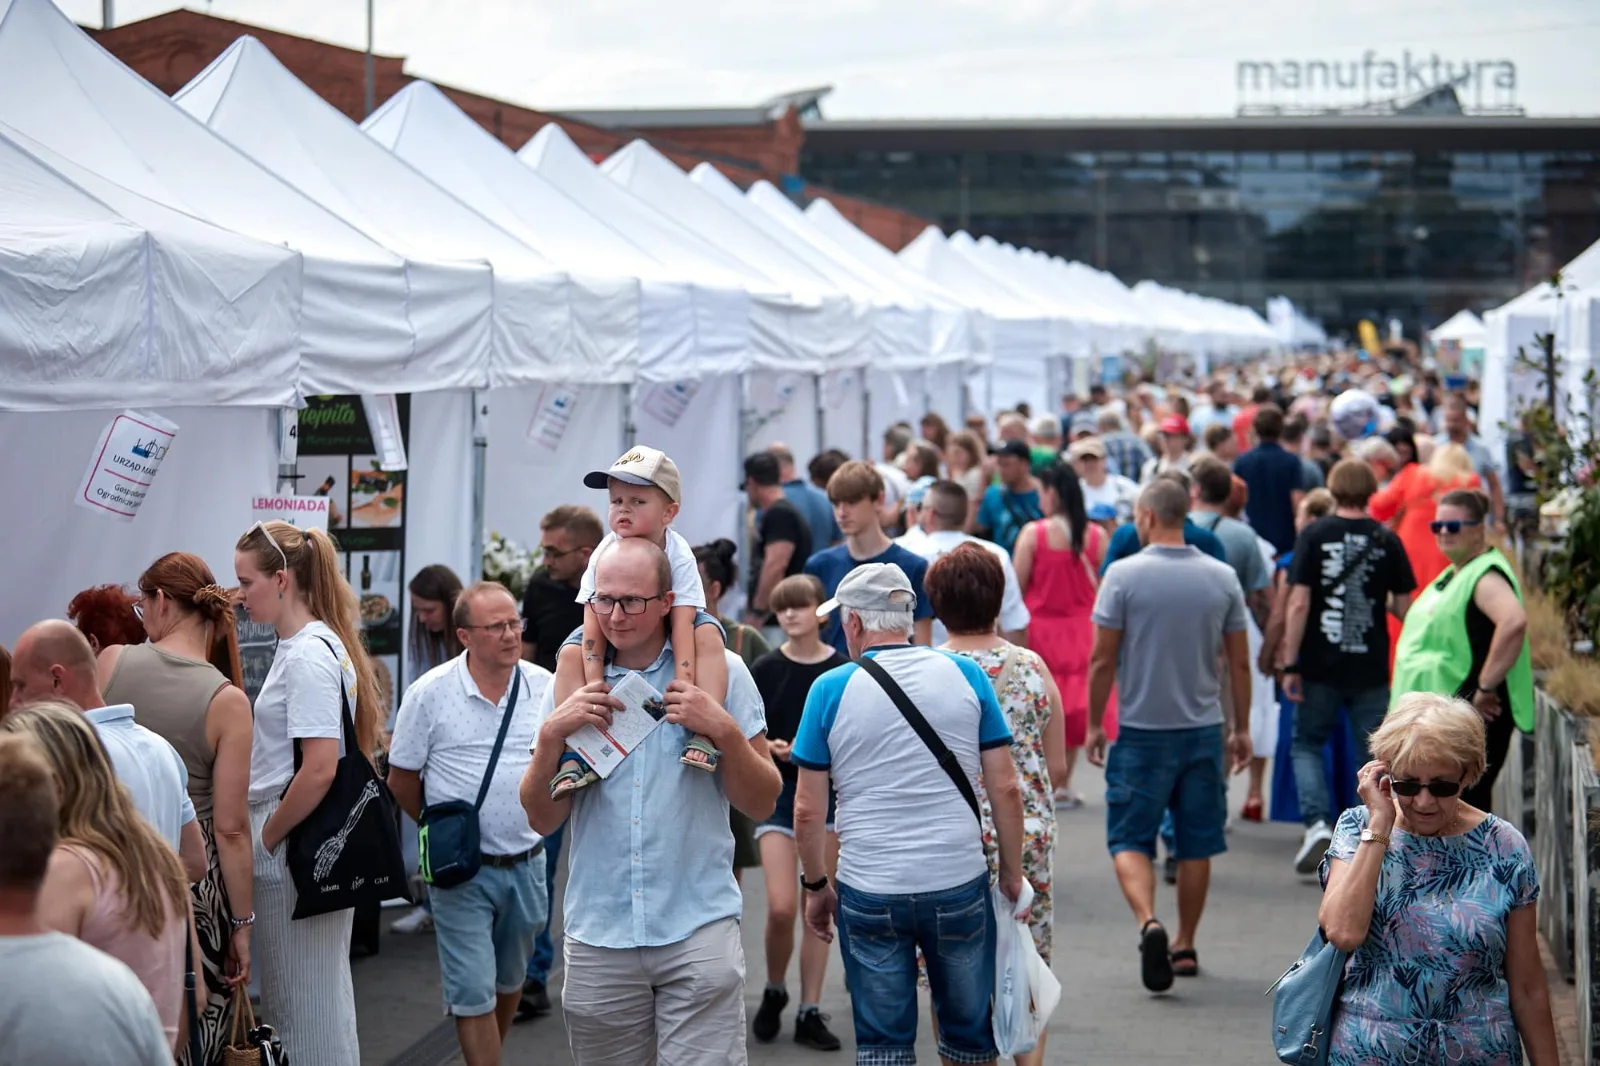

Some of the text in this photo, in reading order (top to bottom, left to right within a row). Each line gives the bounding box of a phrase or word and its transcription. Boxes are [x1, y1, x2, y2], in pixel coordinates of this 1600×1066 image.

[1237, 49, 1516, 90] manufaktura
[113, 454, 141, 472] URZĄD
[252, 497, 326, 512] LEMONIADA
[1320, 609, 1344, 644] UP
